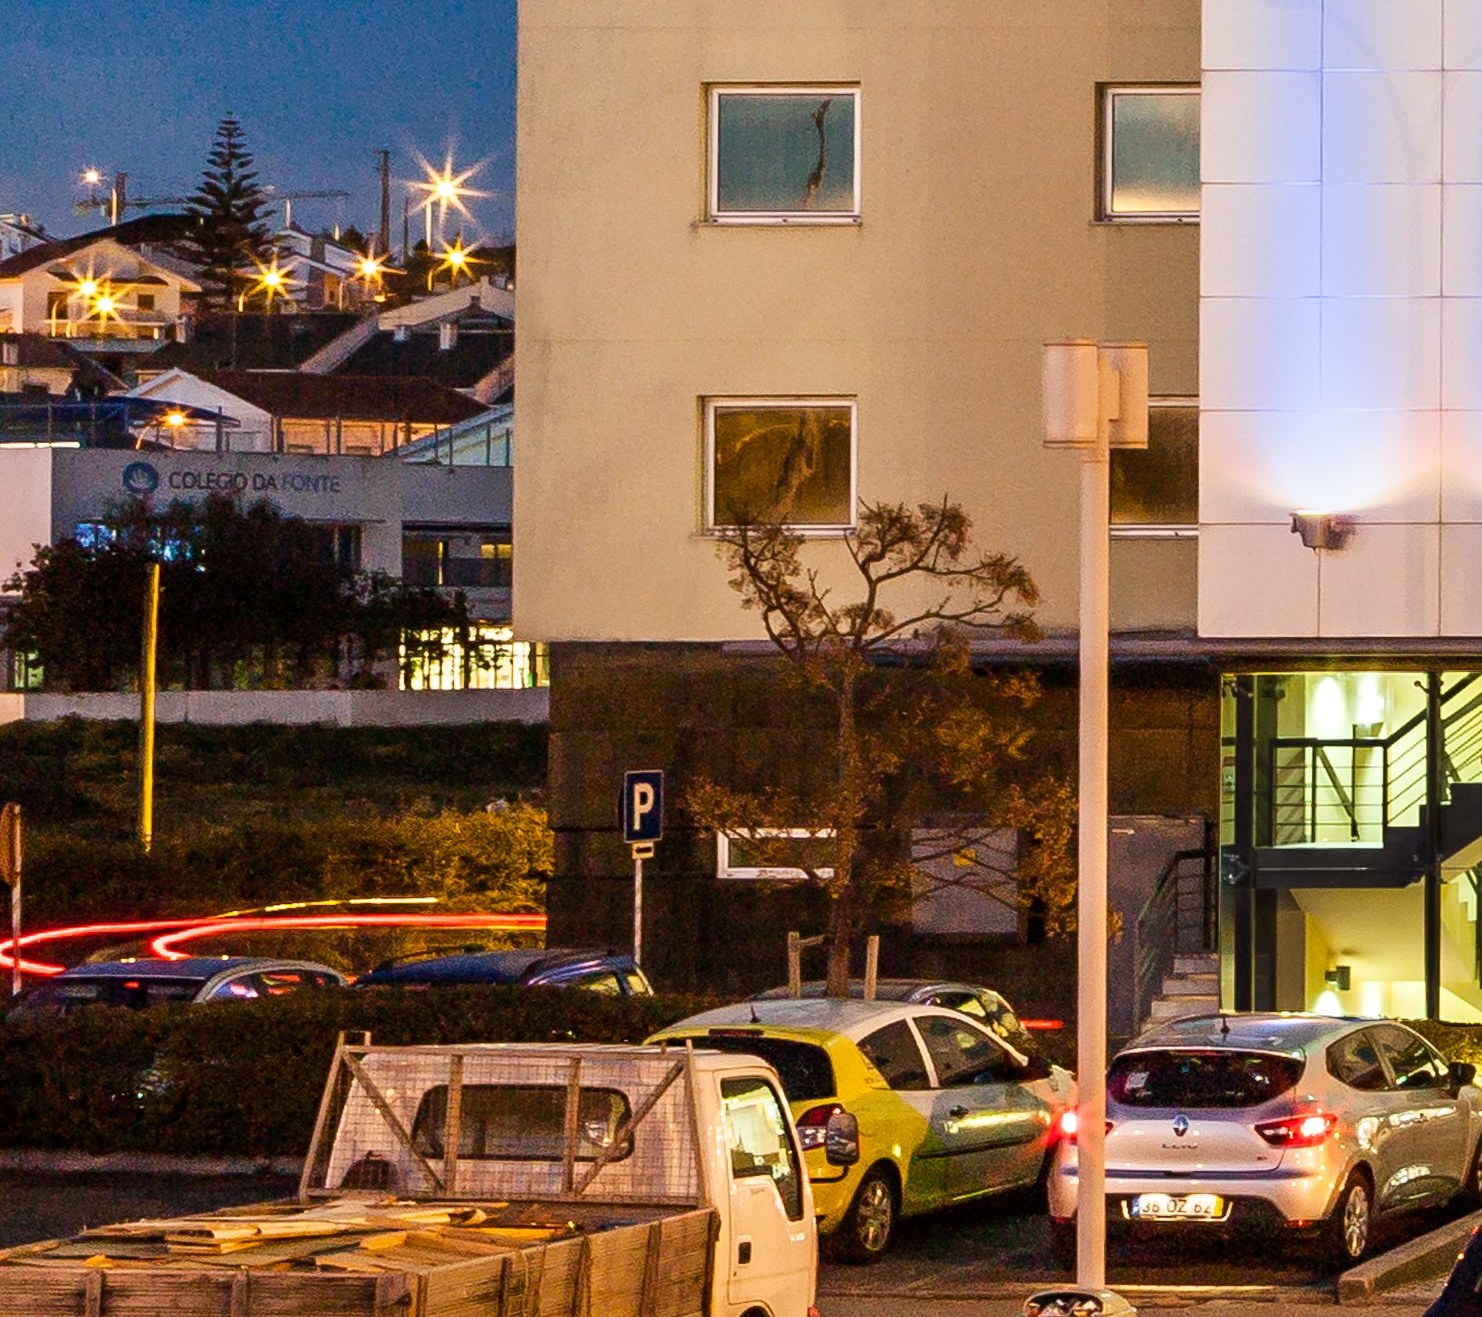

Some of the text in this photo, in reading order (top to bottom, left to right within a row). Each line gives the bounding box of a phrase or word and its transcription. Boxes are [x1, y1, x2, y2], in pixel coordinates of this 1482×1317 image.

[252, 472, 277, 492] DA
[281, 473, 342, 494] FONTE
[633, 782, 655, 831] P
